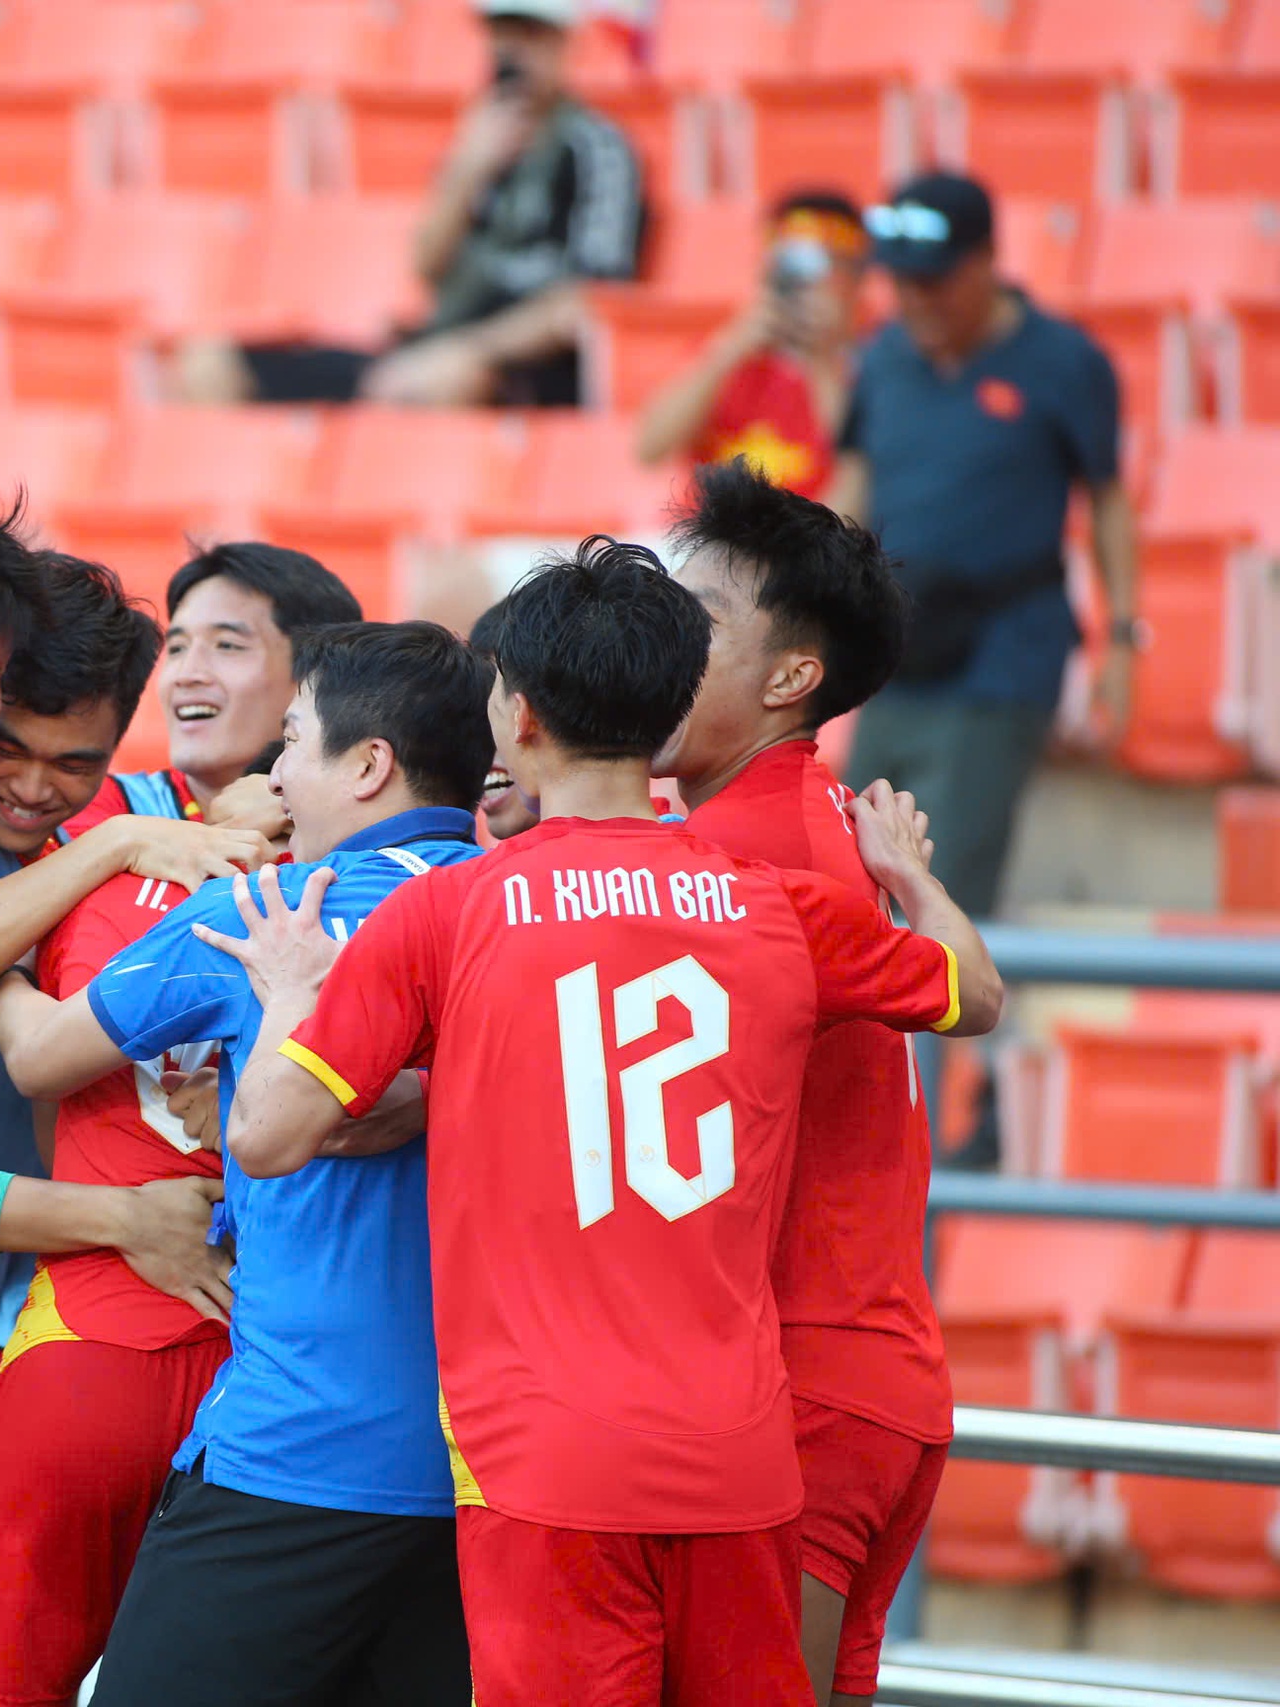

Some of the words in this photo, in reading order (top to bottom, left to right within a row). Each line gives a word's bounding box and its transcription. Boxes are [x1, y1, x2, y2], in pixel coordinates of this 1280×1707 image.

[552, 866, 661, 922] XUAN
[668, 870, 747, 922] BAC
[555, 954, 735, 1230] 12
